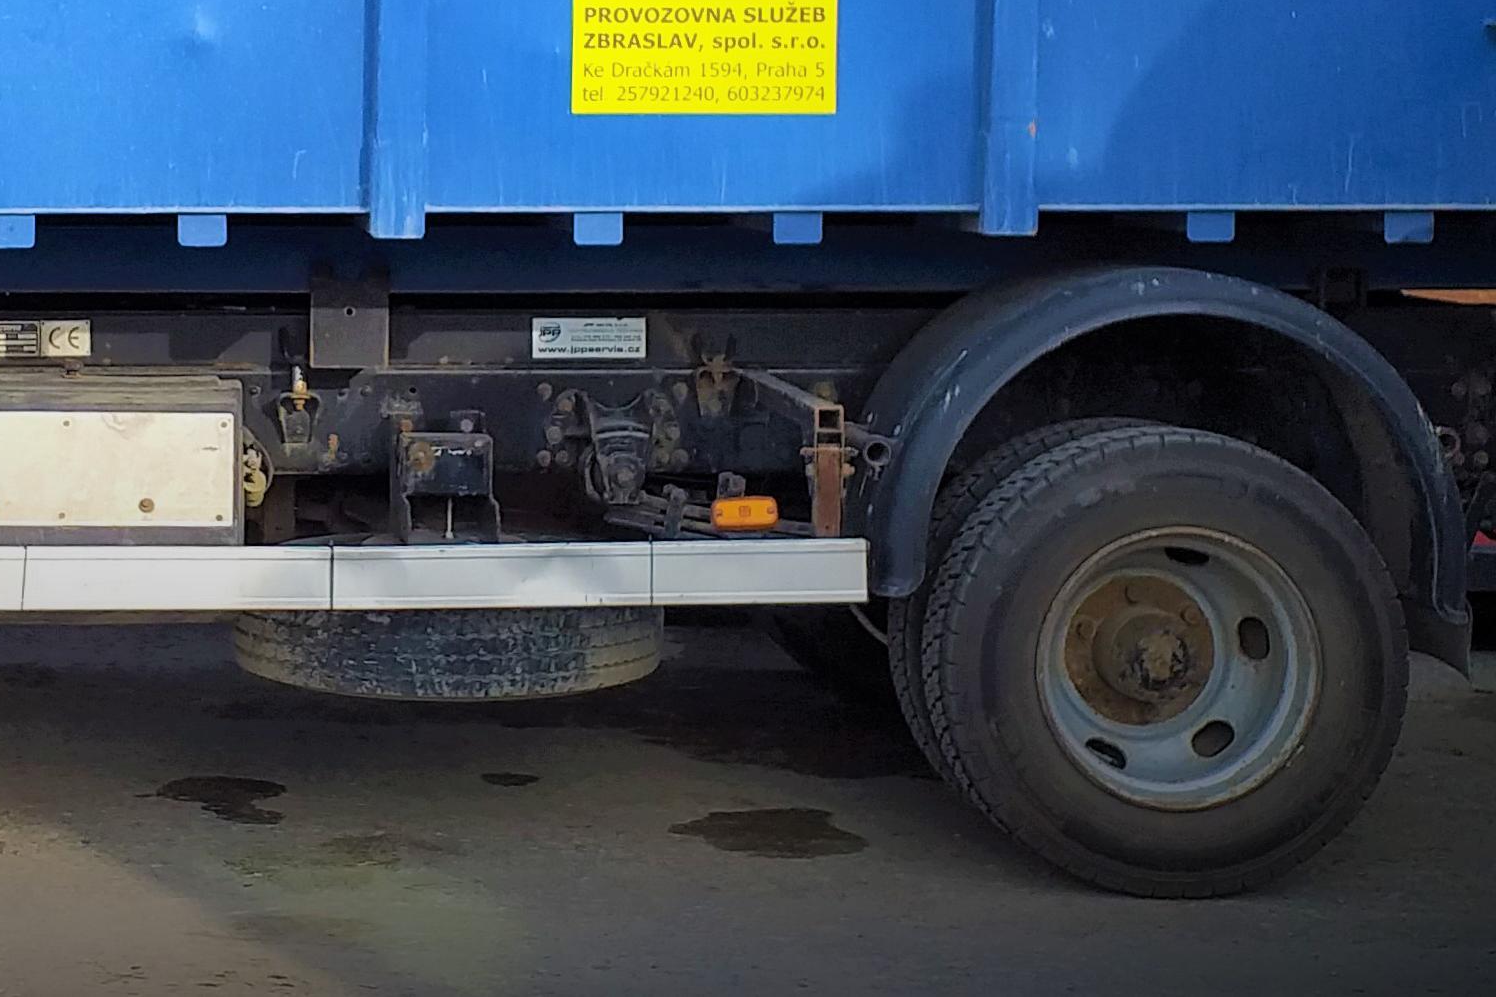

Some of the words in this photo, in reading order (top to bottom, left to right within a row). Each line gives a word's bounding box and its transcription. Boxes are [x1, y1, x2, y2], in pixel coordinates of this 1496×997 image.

[584, 7, 736, 24] PROVOZOVNA
[743, 1, 826, 23] SLUŽEB
[583, 33, 704, 52] ZBRASLAV,
[712, 33, 764, 53] spol.
[771, 35, 826, 49] s.r.o.
[583, 62, 604, 78] Ke
[700, 62, 747, 80] 1594,
[756, 62, 807, 78] Praha
[815, 62, 825, 78] 5
[616, 86, 720, 104] 257921240,
[727, 86, 825, 102] 603237974
[538, 345, 640, 354] www.jppservis.cz
